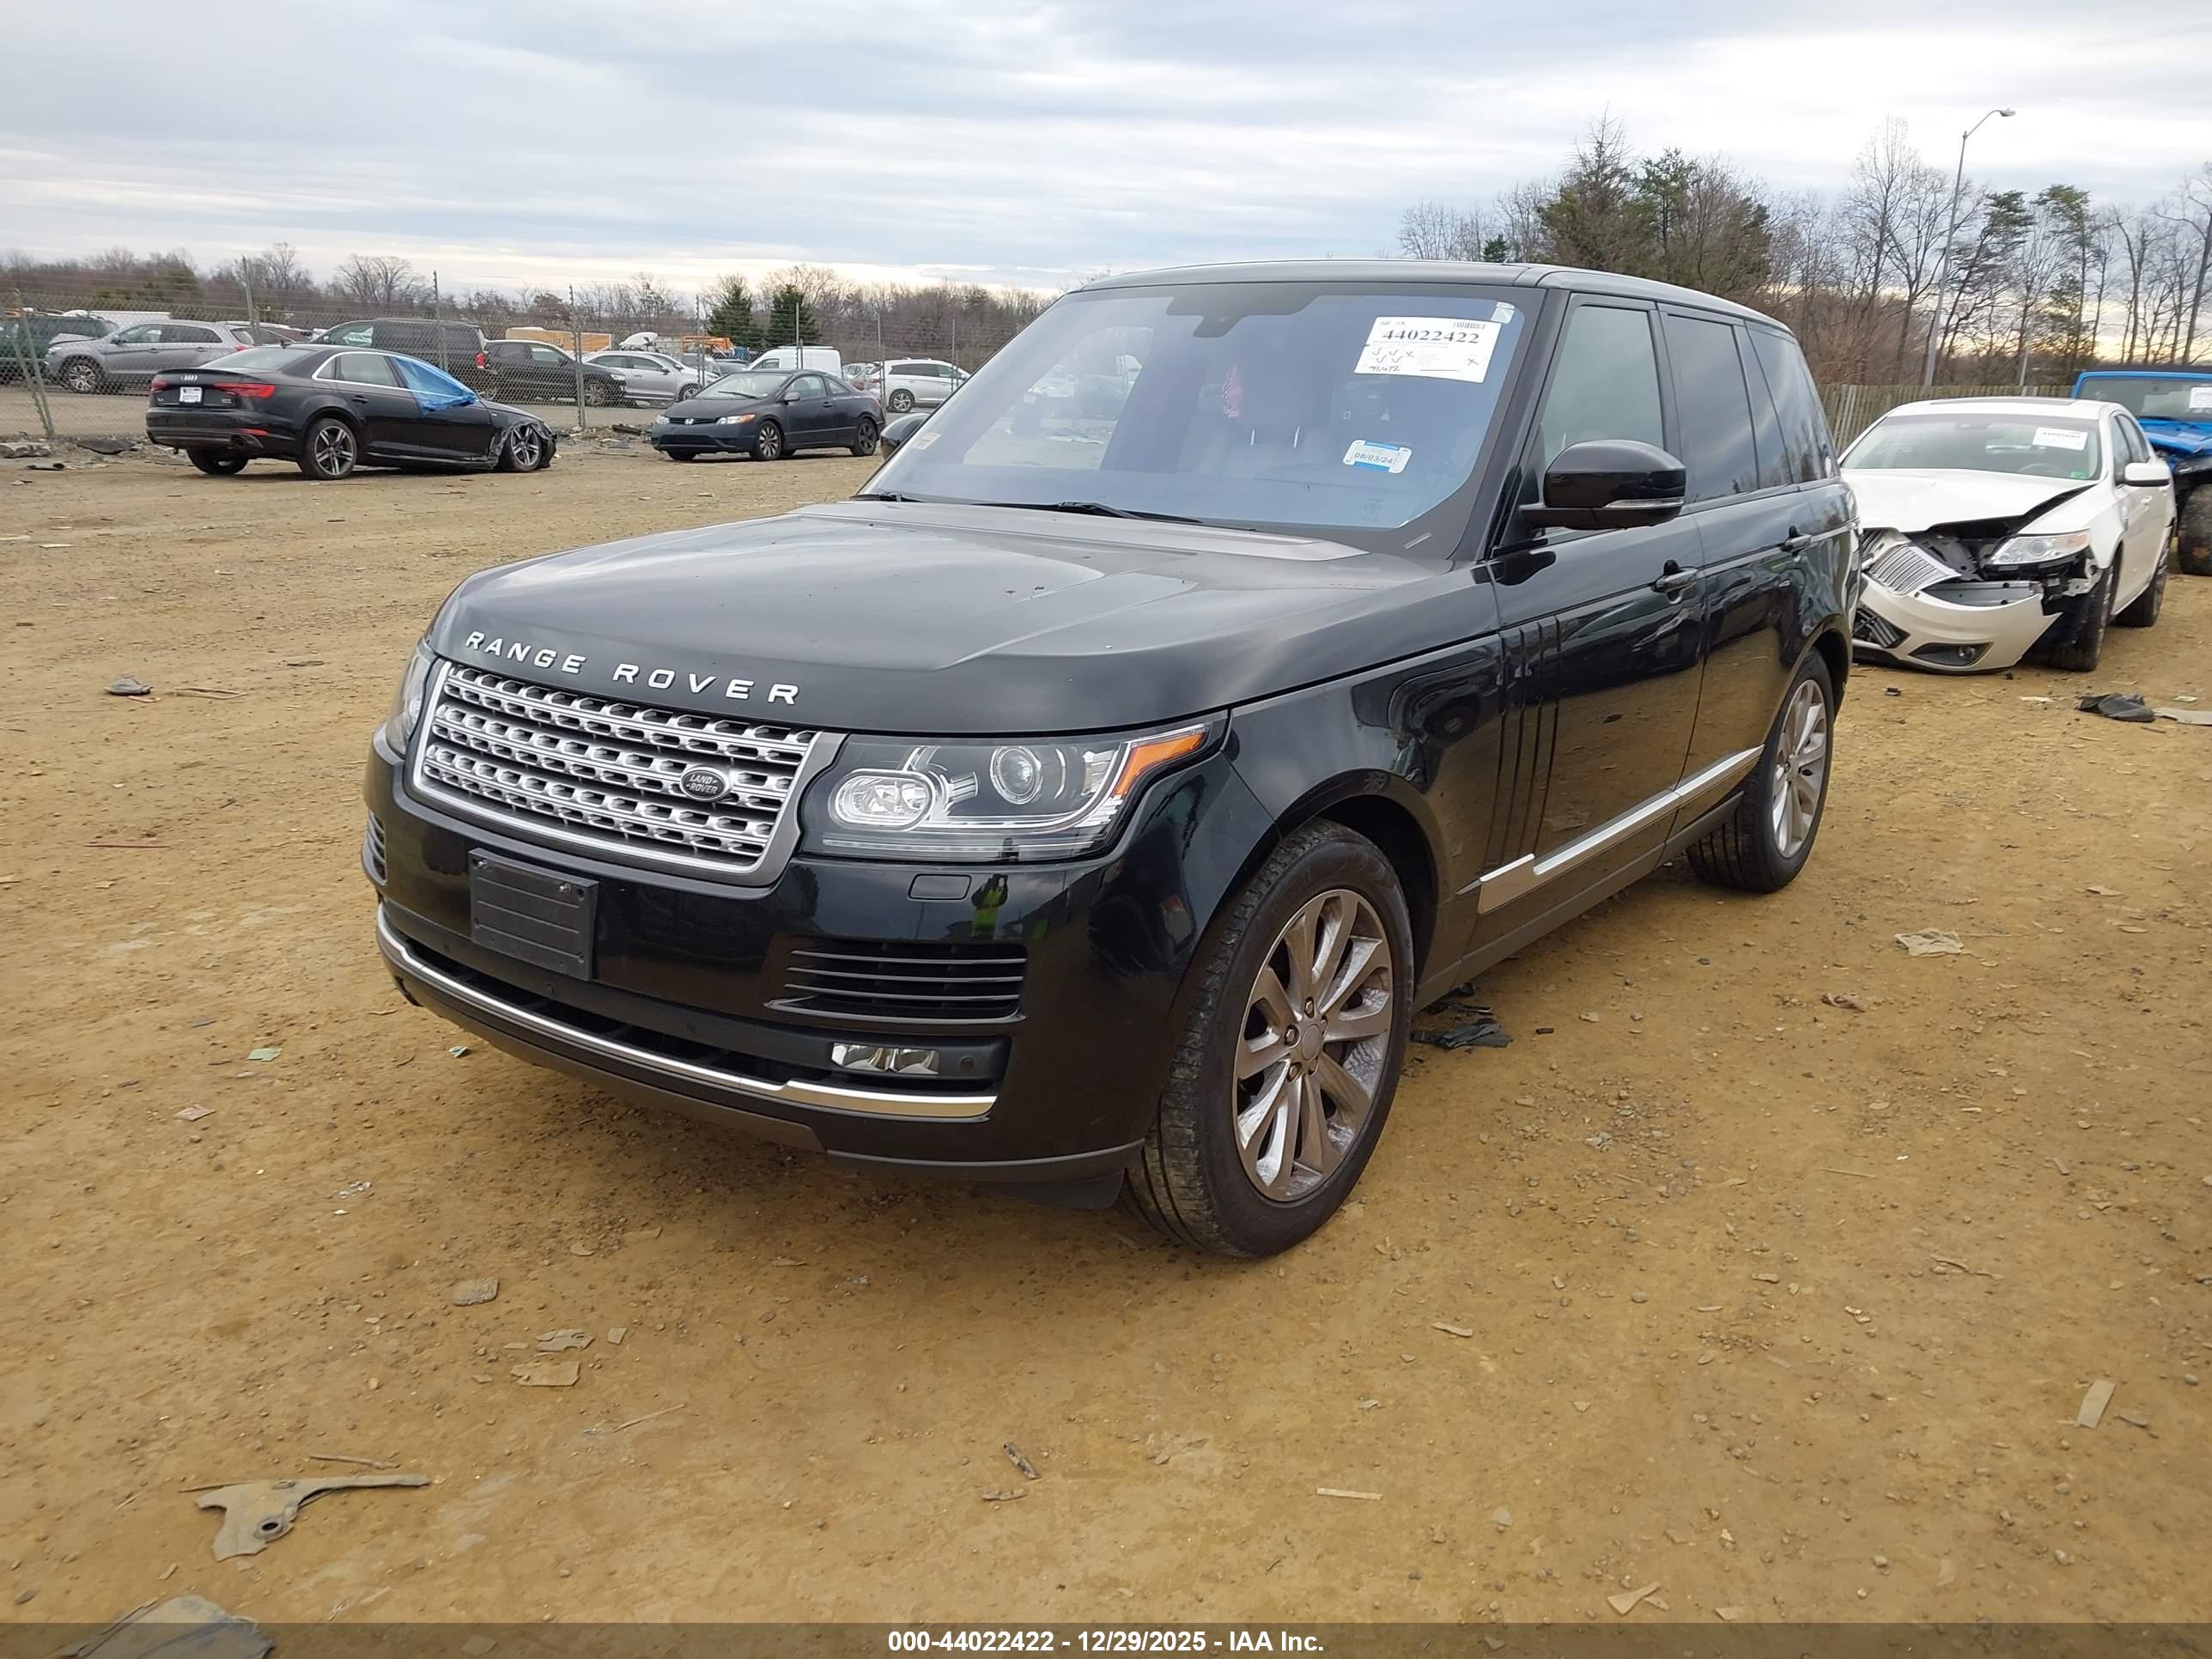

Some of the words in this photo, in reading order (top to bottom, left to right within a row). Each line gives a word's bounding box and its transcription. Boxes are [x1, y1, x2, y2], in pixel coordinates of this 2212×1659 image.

[1382, 329, 1480, 344] 44022422
[465, 630, 587, 674] RANGE
[612, 663, 799, 705] ROVER
[690, 774, 714, 785] LAND
[689, 782, 719, 794] ROVER
